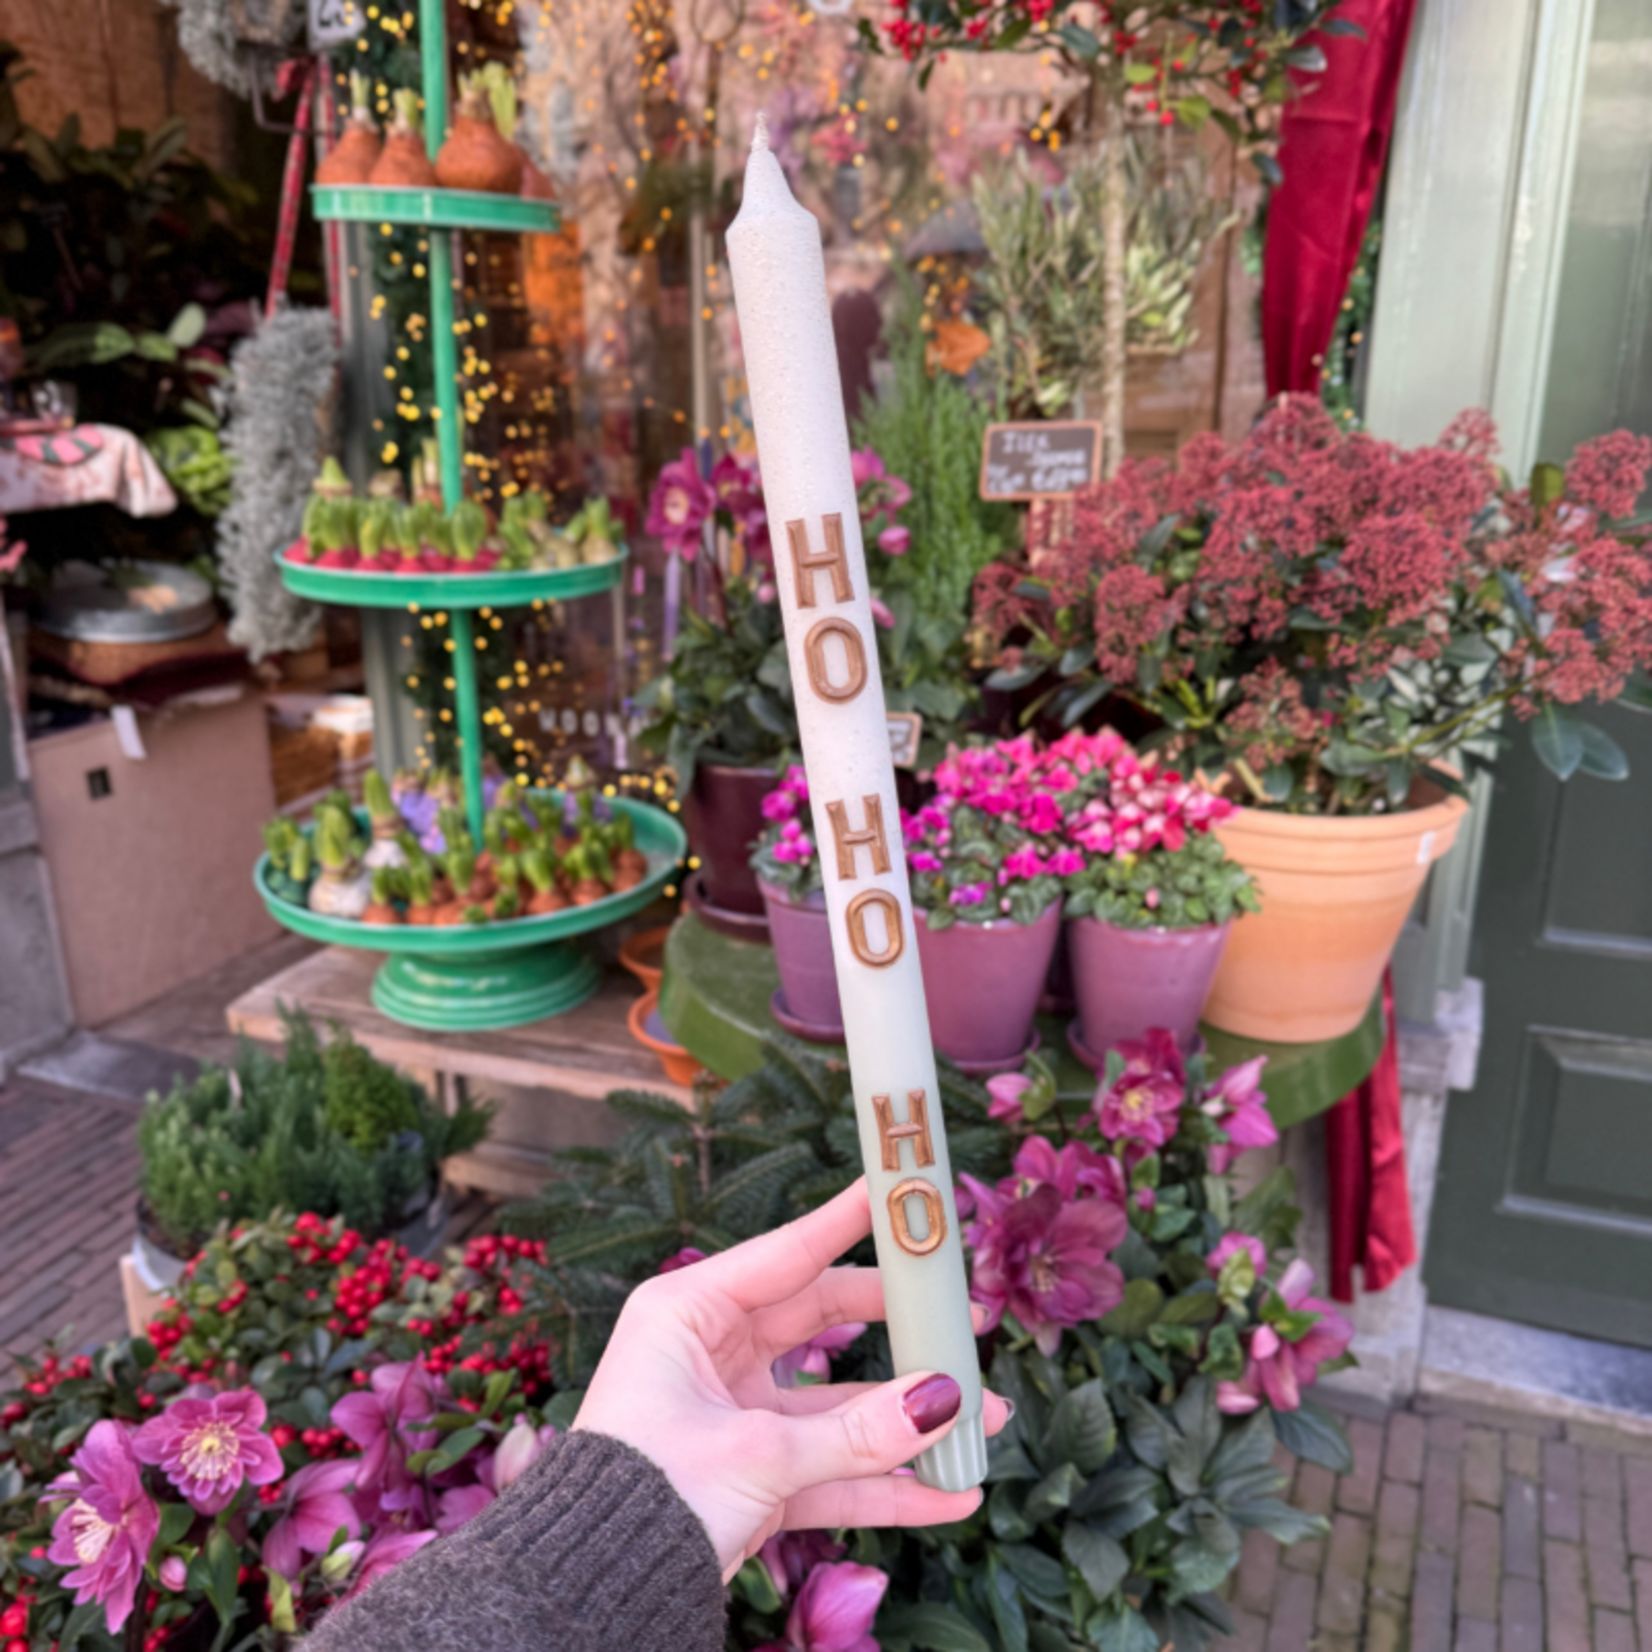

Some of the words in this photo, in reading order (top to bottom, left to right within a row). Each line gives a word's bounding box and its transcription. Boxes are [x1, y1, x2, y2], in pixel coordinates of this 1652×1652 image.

[785, 512, 868, 705] HO
[825, 793, 905, 970] HO
[871, 1088, 948, 1259] HO
